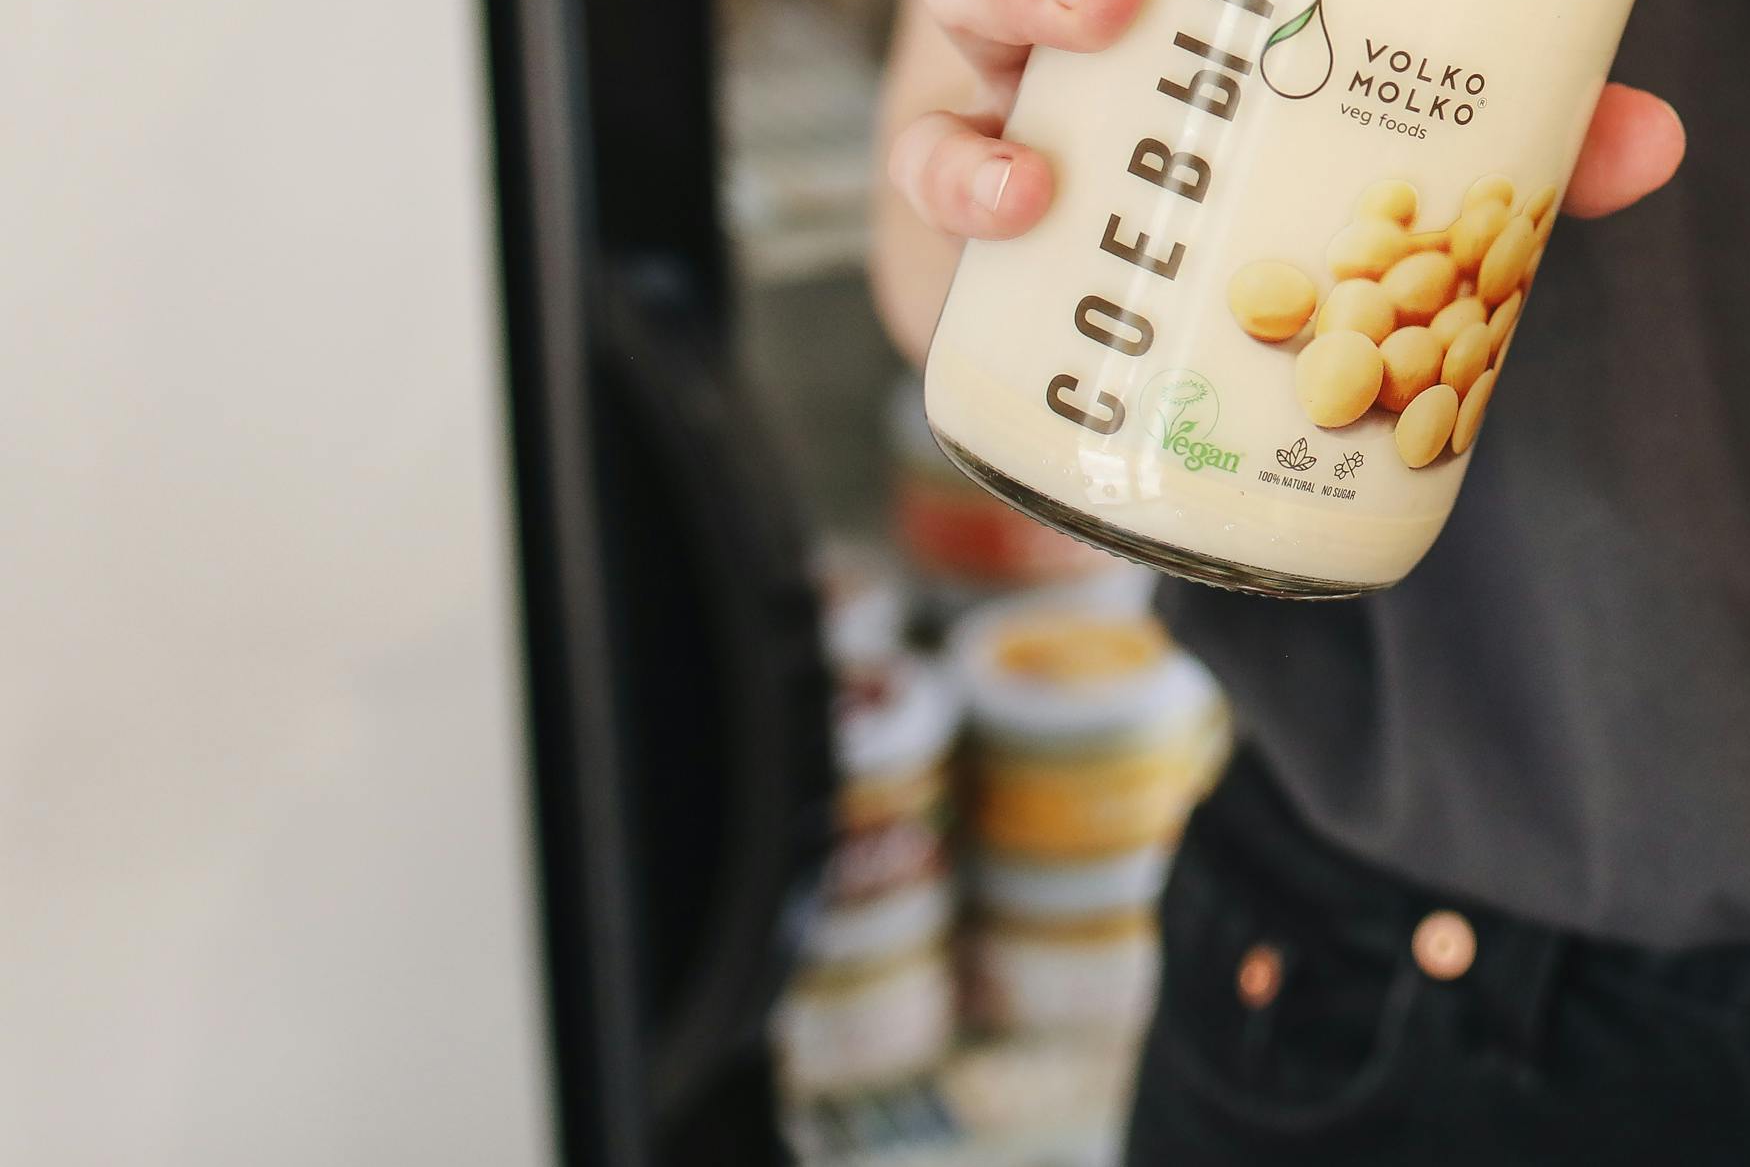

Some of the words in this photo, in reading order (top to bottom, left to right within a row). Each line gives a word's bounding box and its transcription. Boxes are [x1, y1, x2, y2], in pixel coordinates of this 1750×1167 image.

[1366, 38, 1485, 95] VOLKO
[1341, 102, 1372, 126] veg
[1379, 113, 1428, 140] foods
[1157, 420, 1241, 474] Vegan
[1257, 470, 1281, 485] 100%
[1281, 476, 1315, 494] NATURAL
[1321, 485, 1332, 497] NO
[1333, 487, 1356, 501] SUGAR
